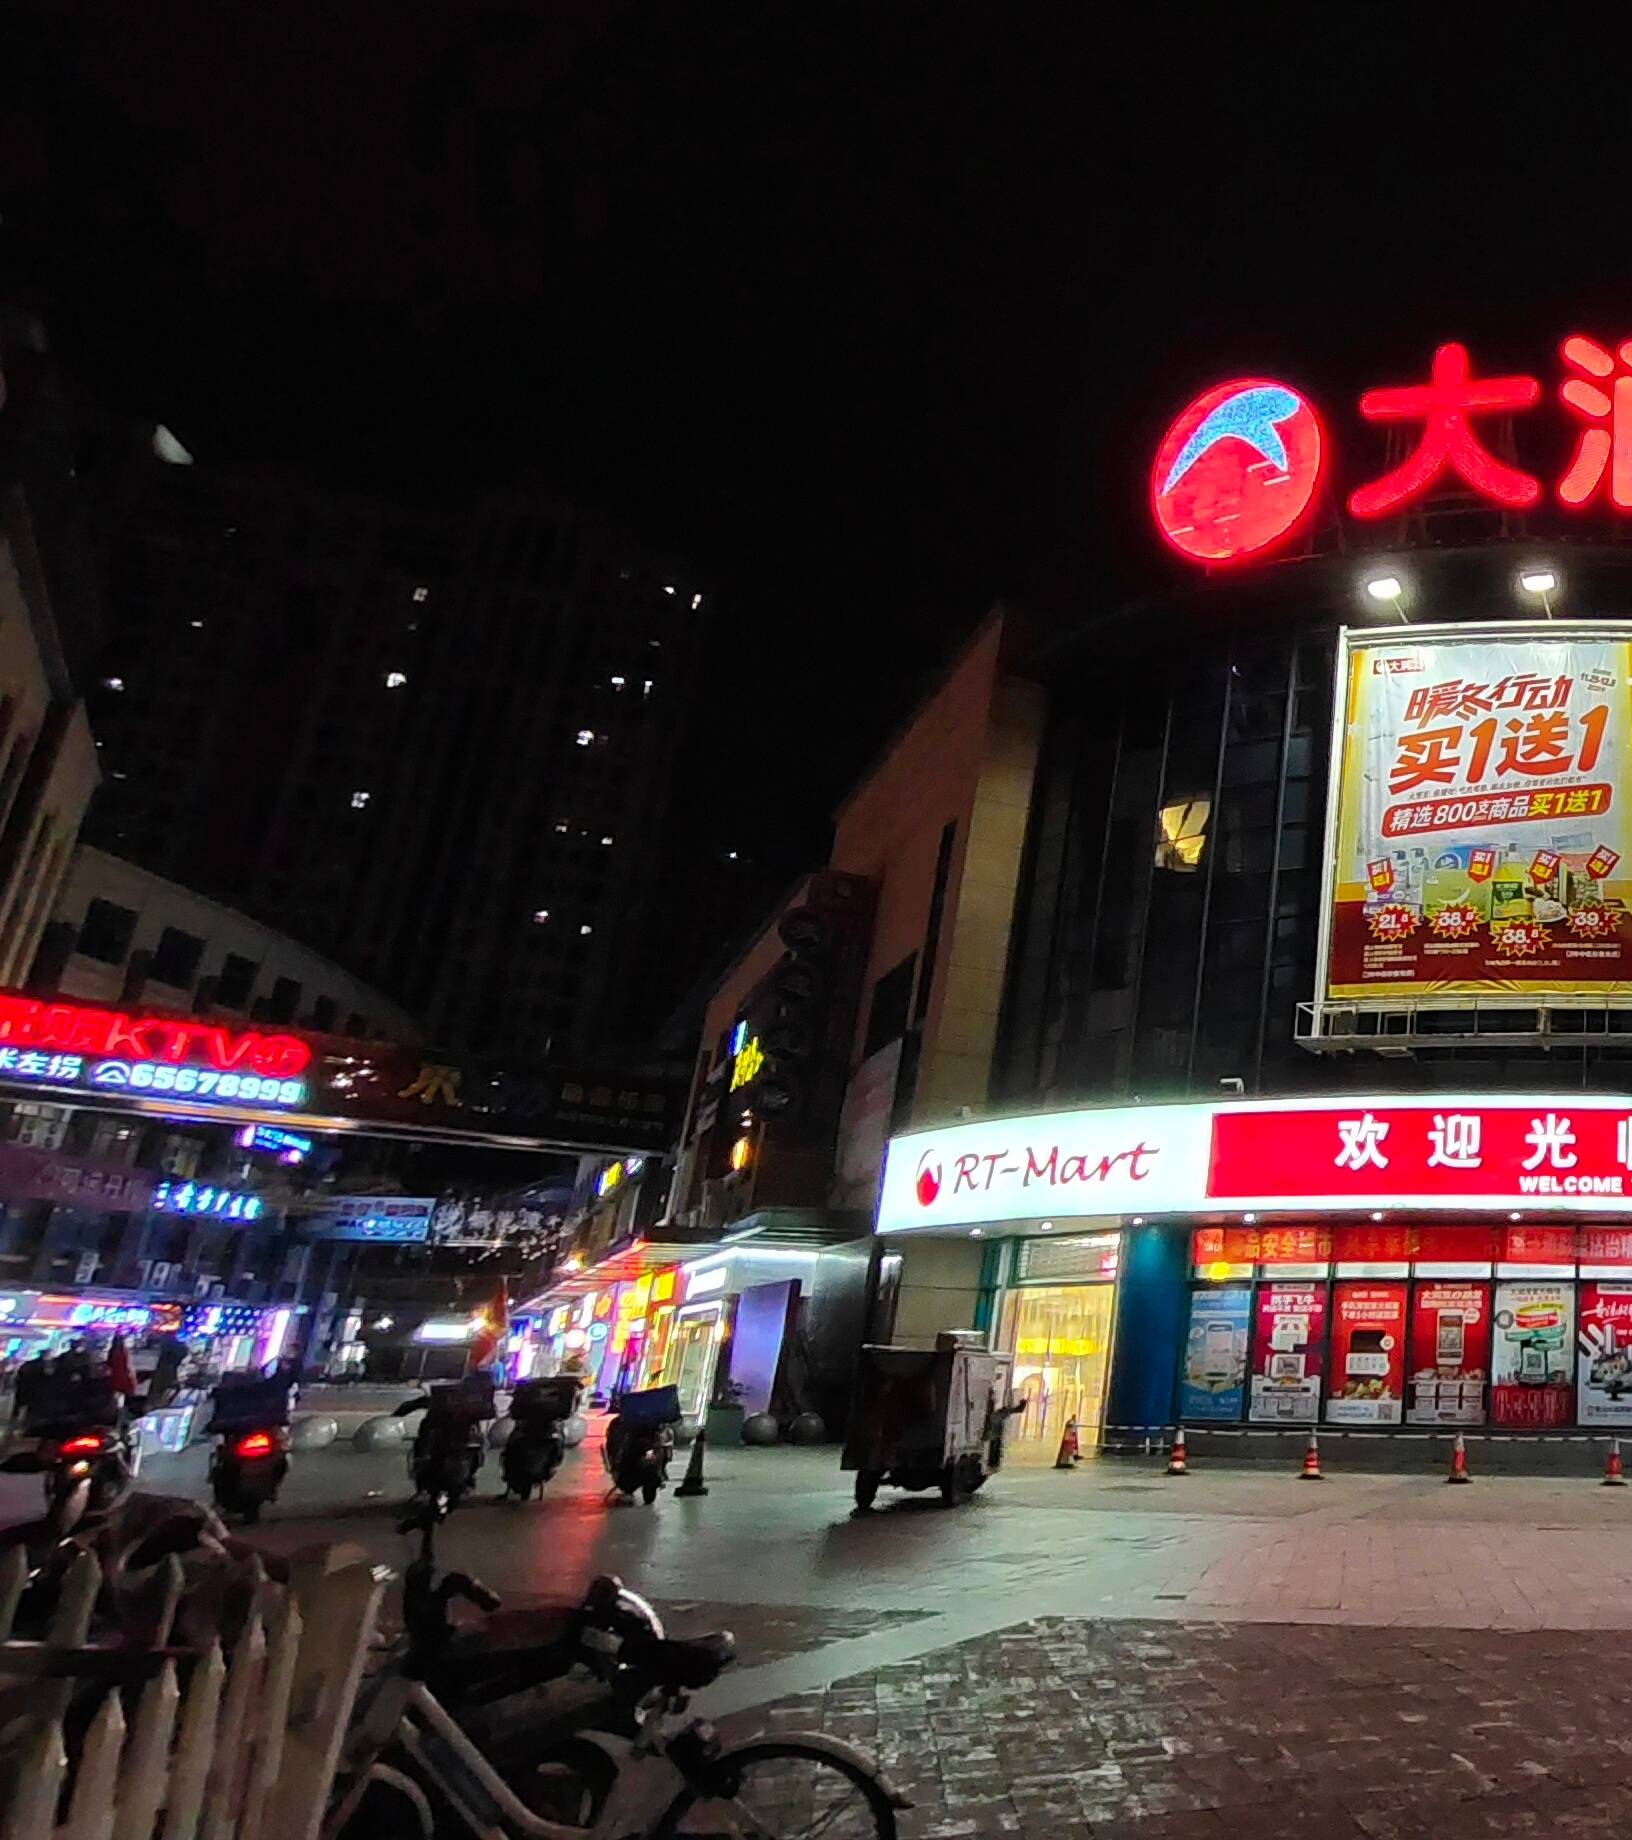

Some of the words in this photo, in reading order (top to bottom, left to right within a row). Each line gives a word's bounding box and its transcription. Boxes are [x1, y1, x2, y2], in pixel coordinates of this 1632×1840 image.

[1404, 673, 1574, 729] 暖冬行动
[1388, 705, 1609, 795] 买1送1
[129, 1063, 303, 1104] 65678999
[953, 1142, 1160, 1193] RT-Mart
[1519, 1176, 1622, 1194] WELCOME
